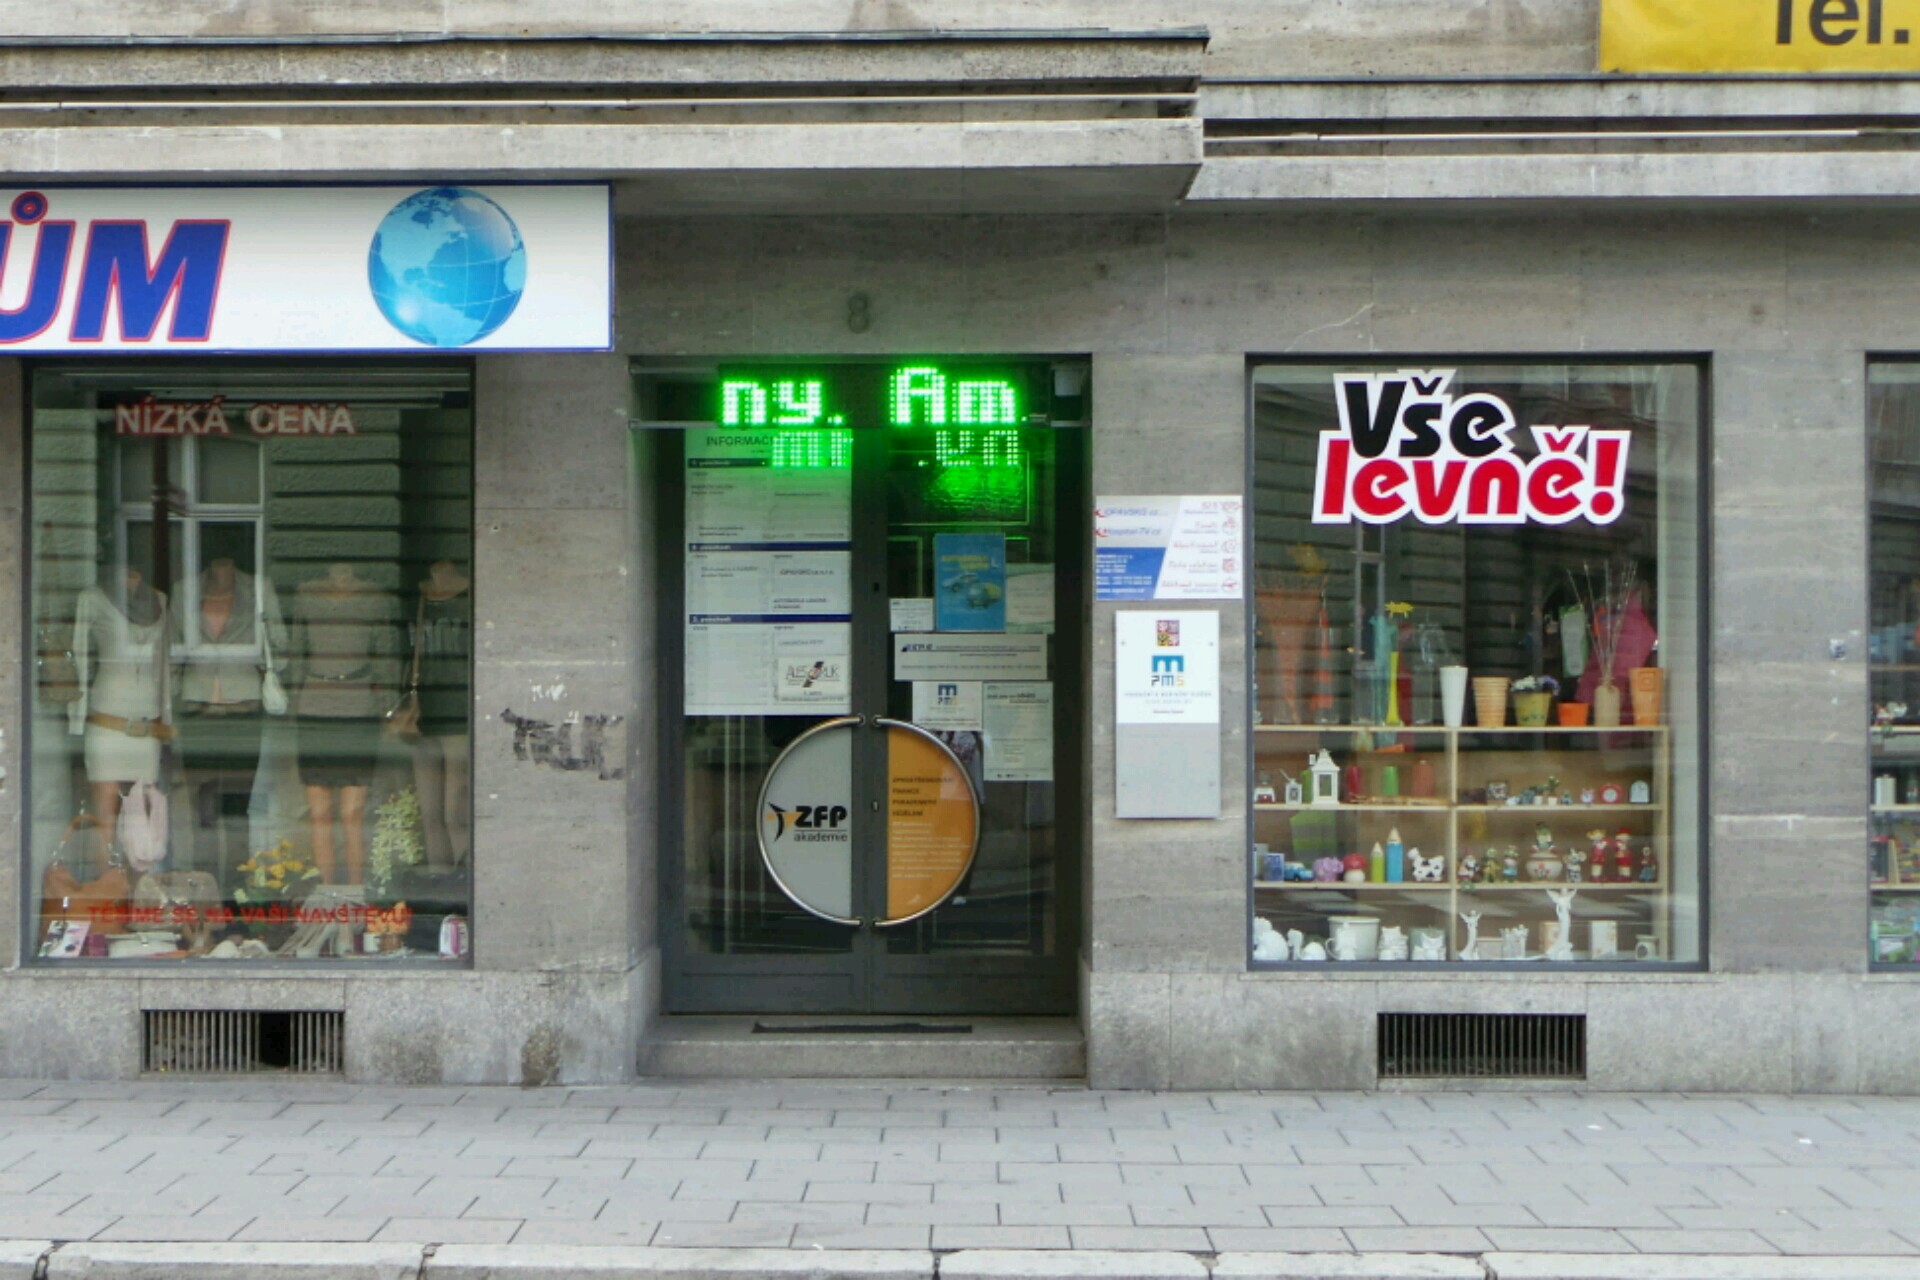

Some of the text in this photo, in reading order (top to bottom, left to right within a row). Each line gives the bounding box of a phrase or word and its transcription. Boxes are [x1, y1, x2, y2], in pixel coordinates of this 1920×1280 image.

[1775, 0, 1911, 46] Tel.
[114, 395, 357, 435] NÍZKÁ CENA
[1342, 375, 1507, 459] Vše
[1320, 430, 1622, 517] levně!
[794, 805, 848, 828] ZFP
[794, 831, 849, 842] akademie
